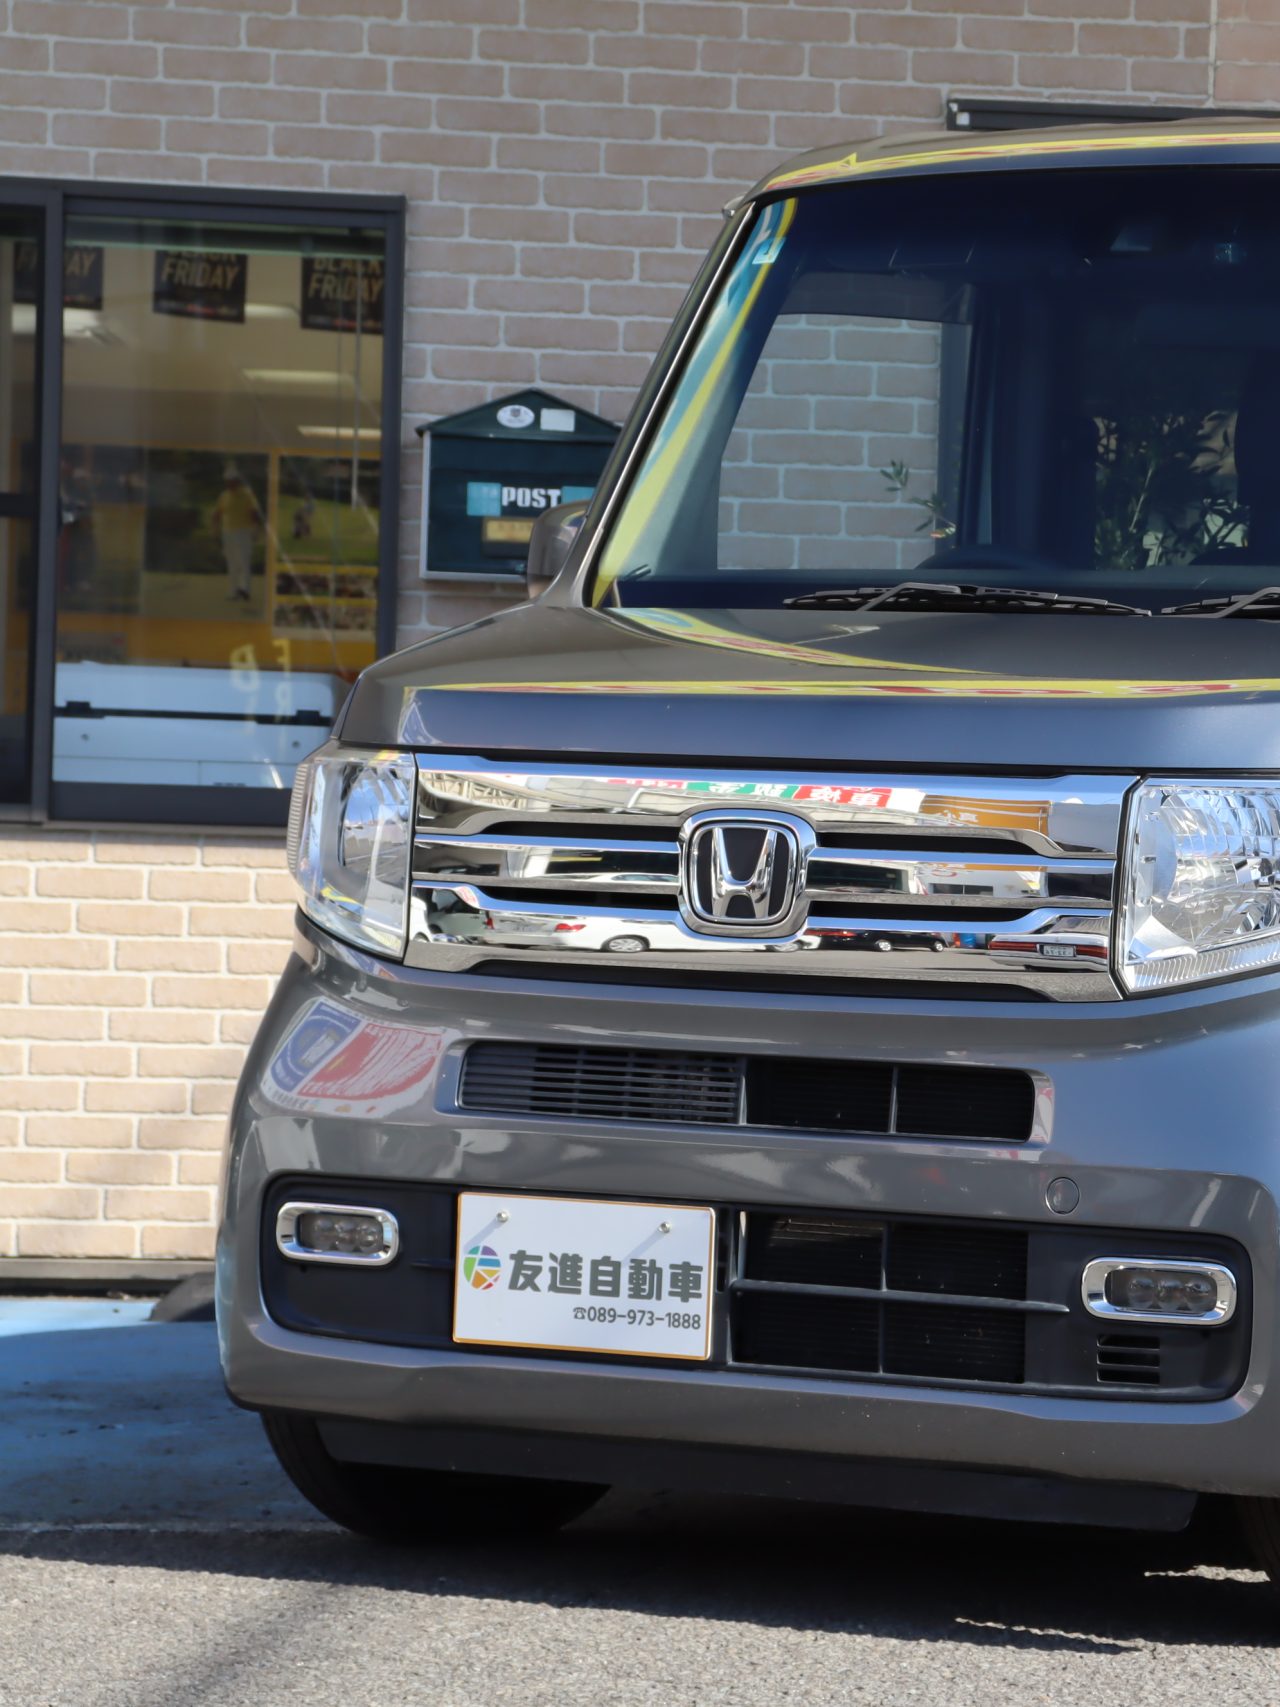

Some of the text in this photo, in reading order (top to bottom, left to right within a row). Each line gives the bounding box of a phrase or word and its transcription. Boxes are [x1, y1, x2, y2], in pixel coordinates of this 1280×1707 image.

[159, 257, 240, 290] FRIDAY
[307, 271, 385, 303] FRIDAY
[502, 486, 561, 508] POST
[508, 1249, 704, 1303] 友進自動車
[587, 1306, 701, 1330] 089-973-1888
